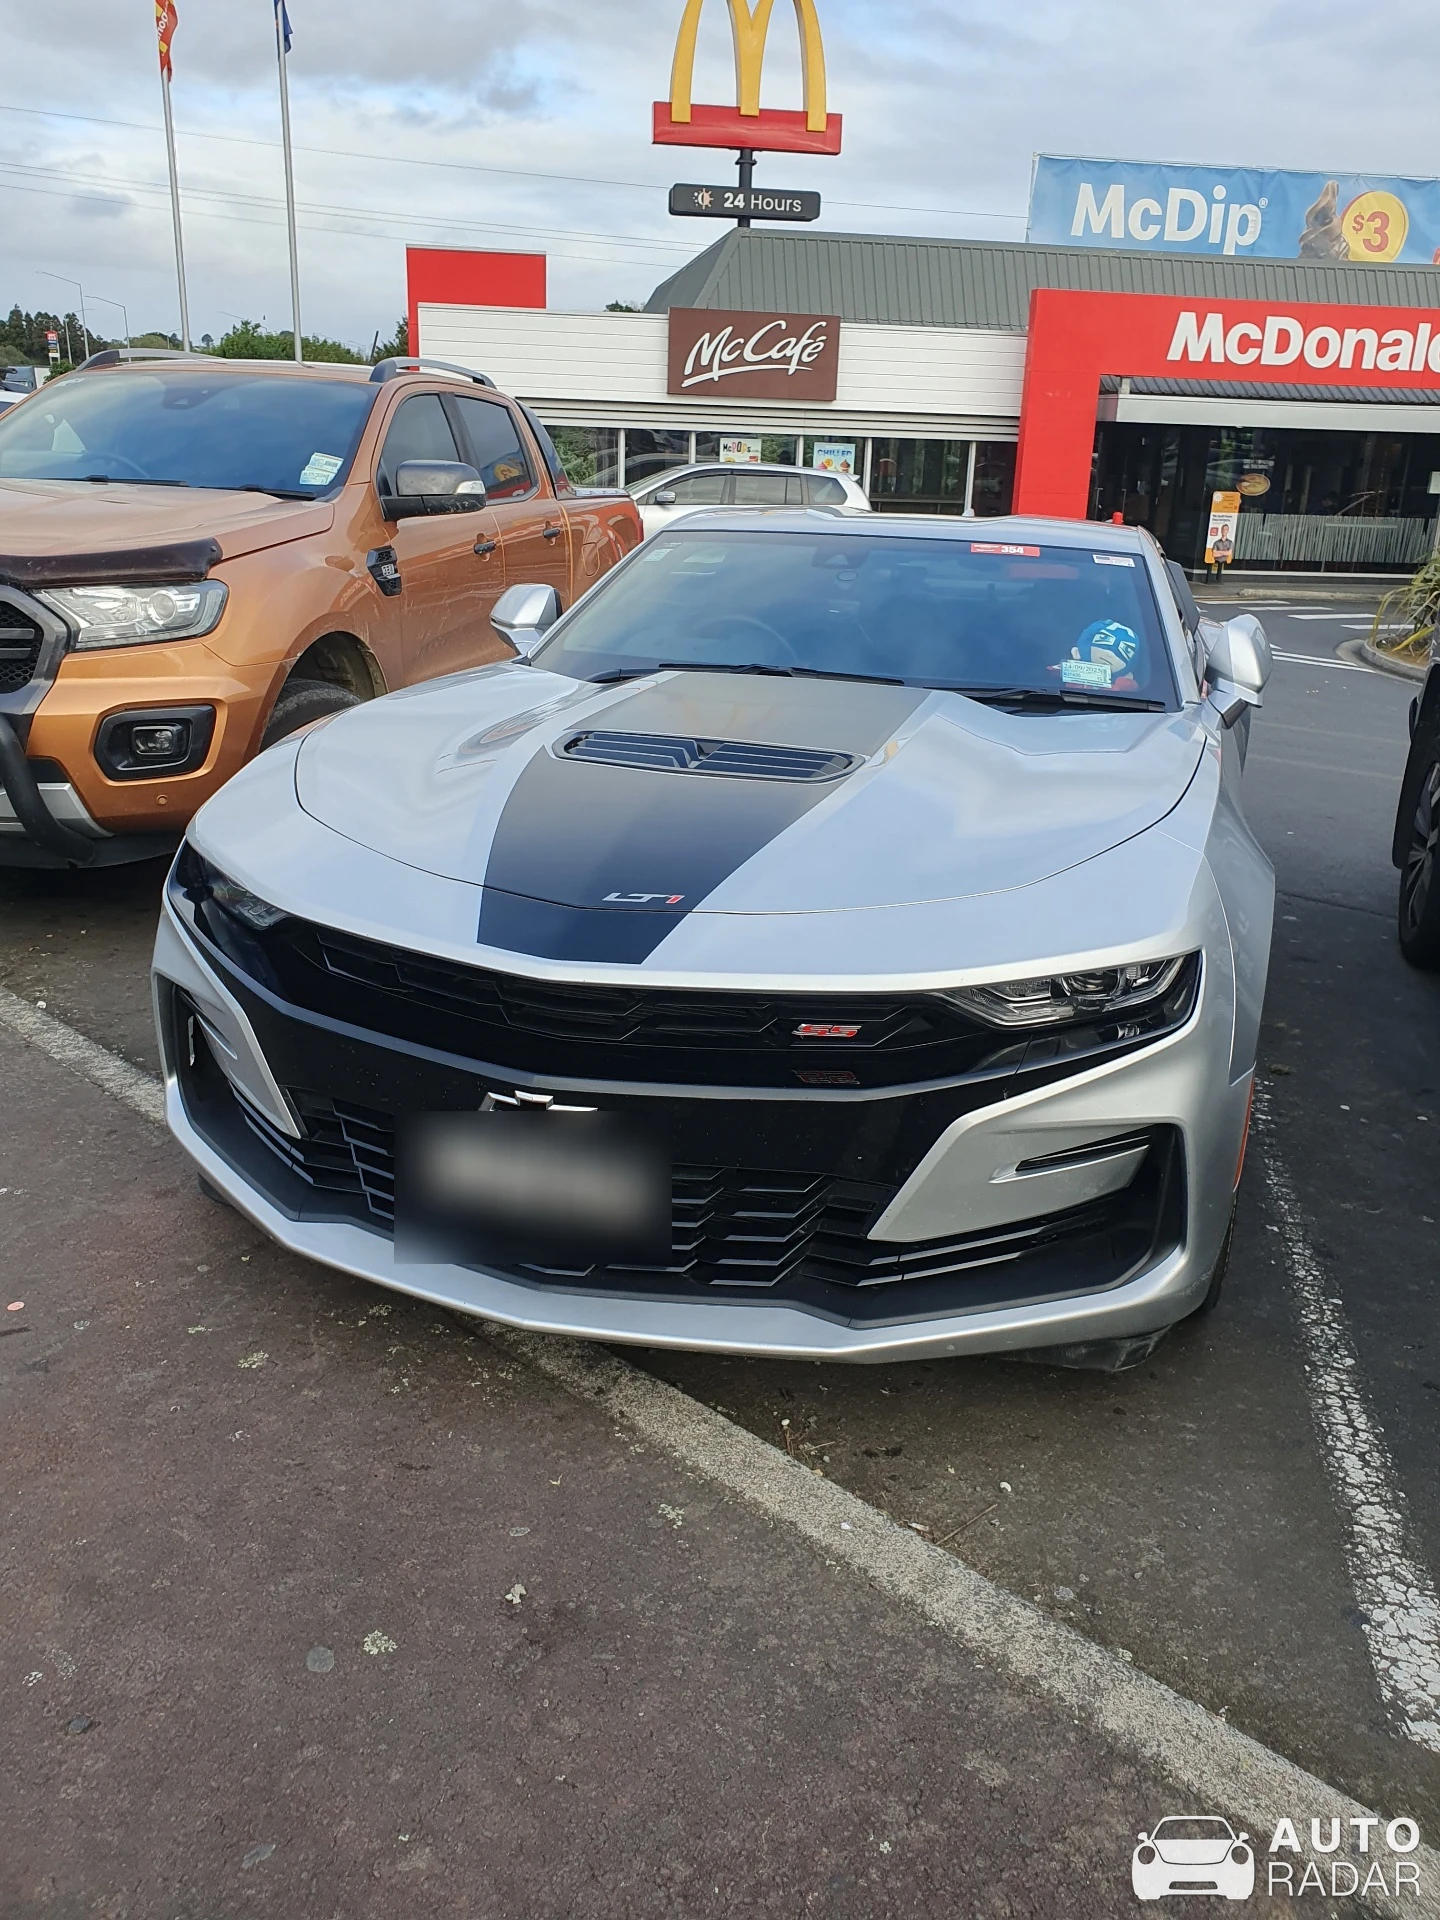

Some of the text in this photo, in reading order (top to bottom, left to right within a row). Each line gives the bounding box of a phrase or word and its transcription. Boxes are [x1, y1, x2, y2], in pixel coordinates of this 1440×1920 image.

[723, 192, 802, 212] 24 Hours
[1351, 210, 1390, 253] $3
[683, 320, 828, 382] McCafé
[1165, 311, 1440, 374] McDonal
[1001, 545, 1024, 555] 354
[1064, 663, 1102, 675] 24/09/2025
[602, 892, 685, 904] LT1
[791, 1023, 863, 1038] SS
